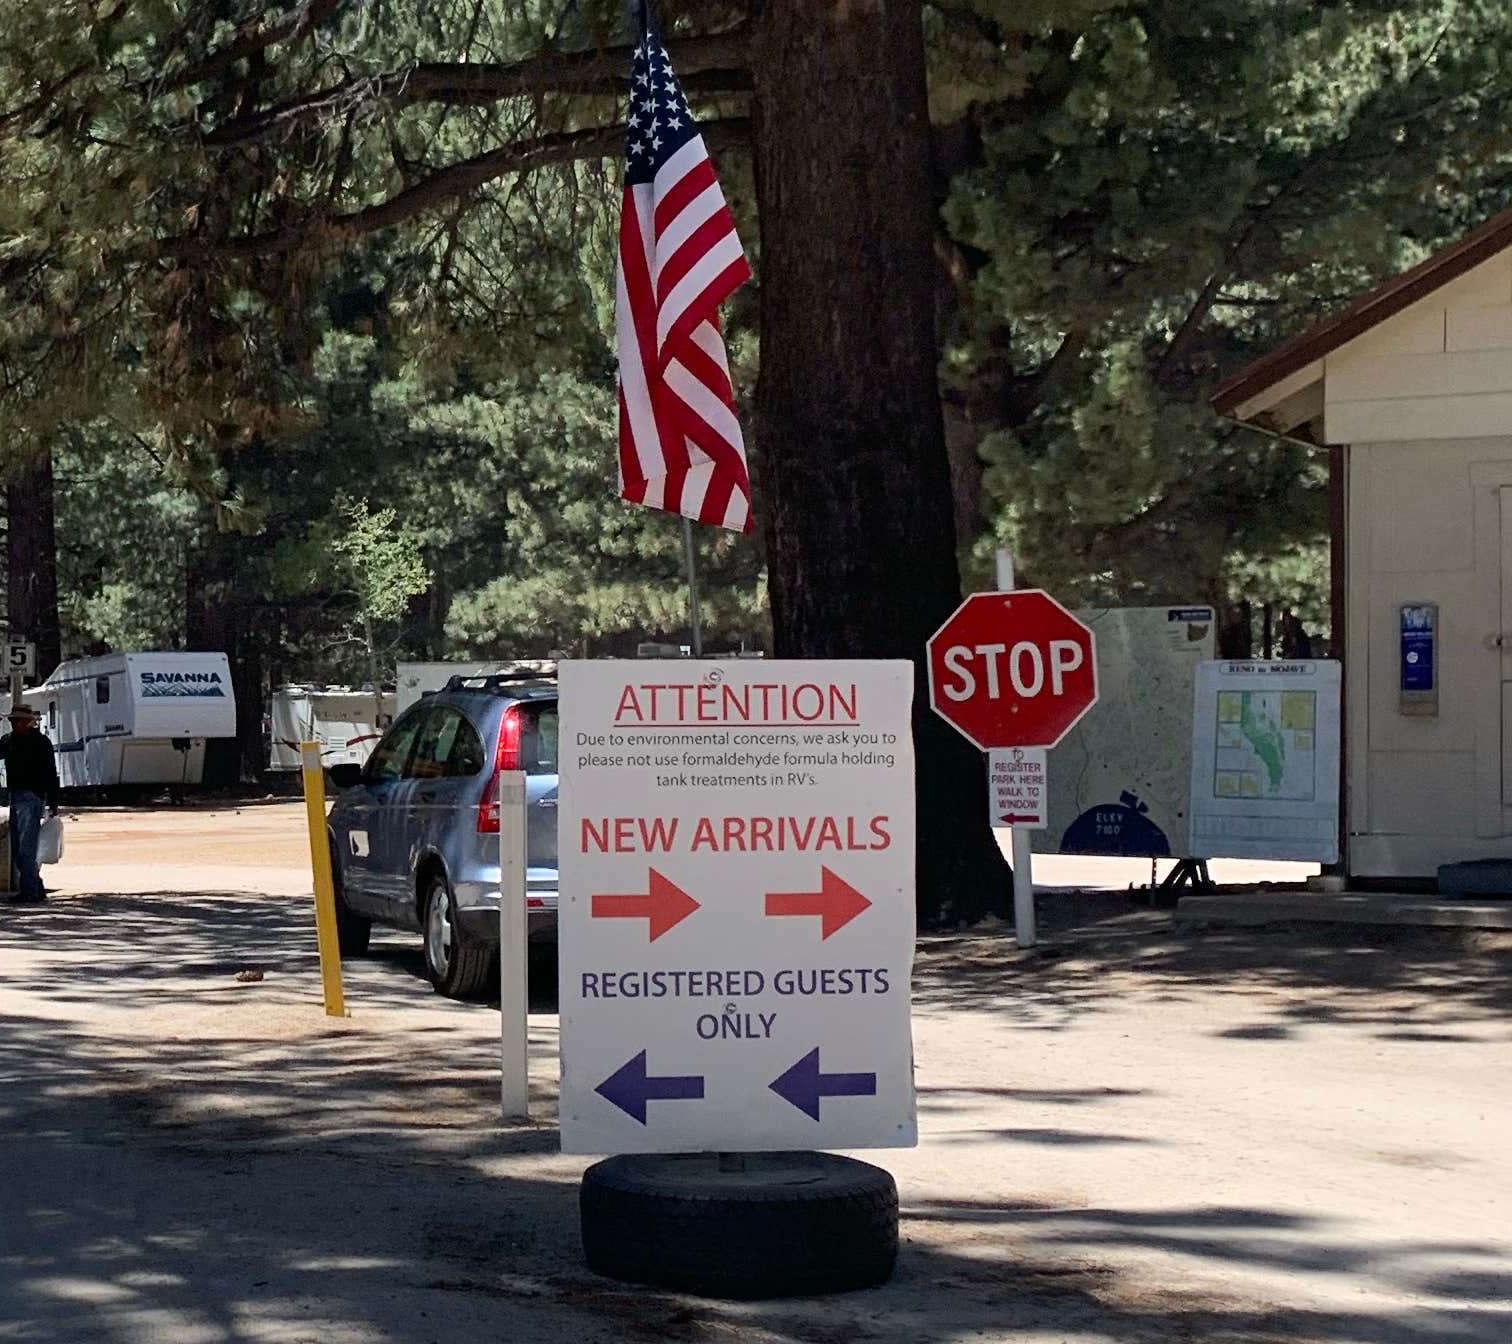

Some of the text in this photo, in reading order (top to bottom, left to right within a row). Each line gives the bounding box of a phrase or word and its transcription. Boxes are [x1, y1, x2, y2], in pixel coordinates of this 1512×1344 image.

[10, 647, 27, 665] 5
[140, 672, 222, 683] SAVANNA
[943, 640, 1083, 702] STOP
[614, 684, 857, 721] ATTENTION
[576, 732, 897, 748] Due to environmental concerns, we ask you to
[578, 751, 895, 769] please not use formaldehyde formula holding
[995, 762, 1041, 772] REGISTER
[656, 774, 687, 787] tank
[691, 774, 767, 787] treatments
[771, 774, 783, 786] in
[991, 774, 1045, 784] PARK HERE
[998, 787, 1040, 796] WALK TO
[999, 799, 1039, 808] WINDOW
[581, 816, 892, 853] NEW ARRIVALS
[581, 968, 890, 998] REGISTERED GUESTS
[695, 1012, 777, 1040] ONLY
